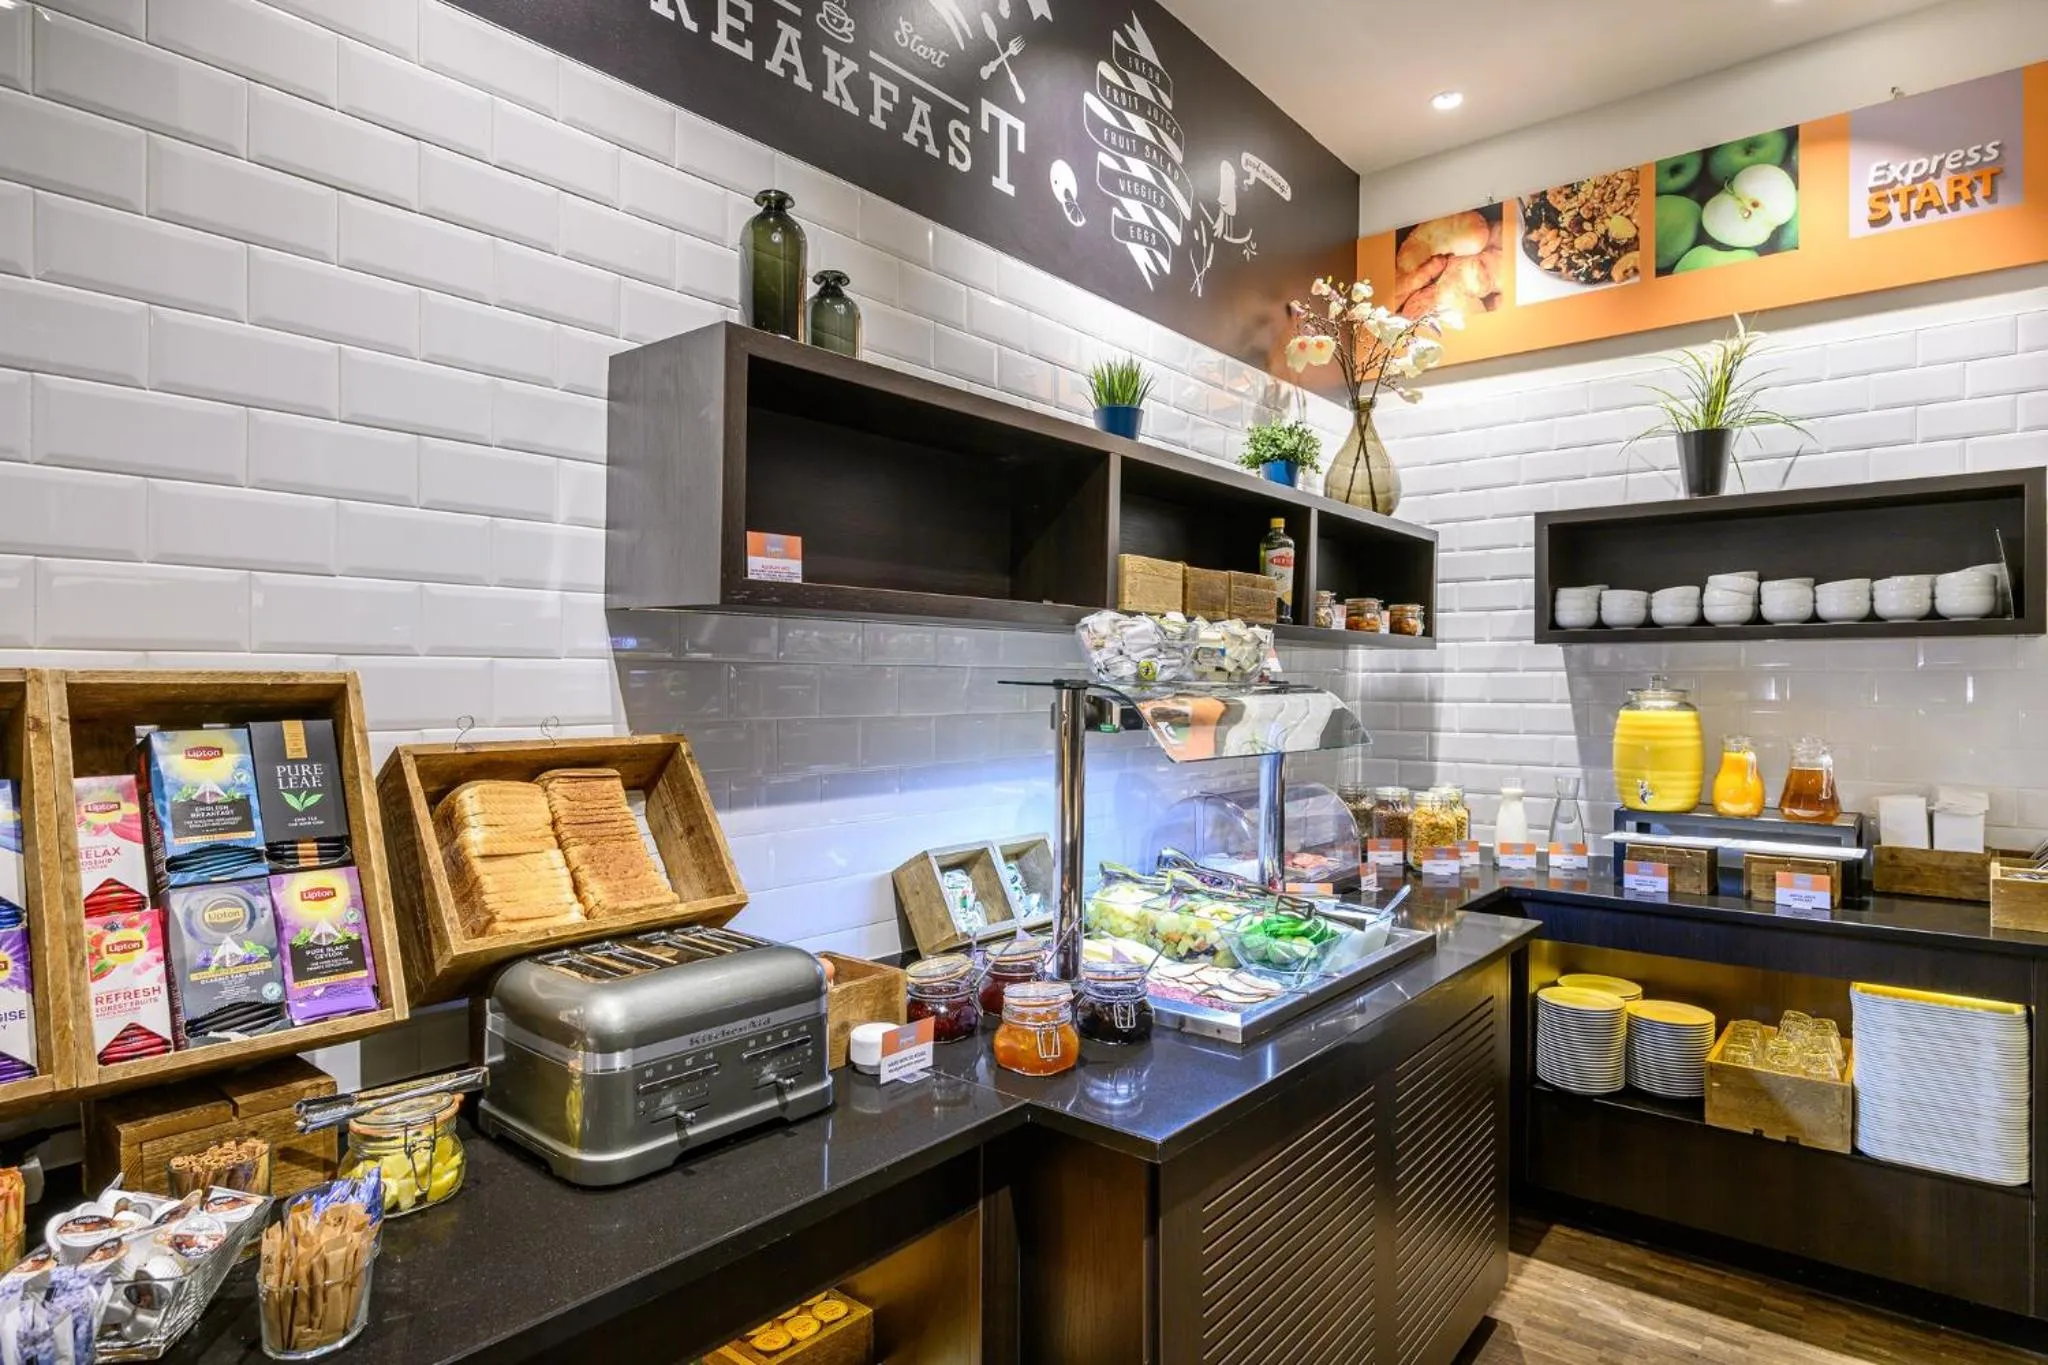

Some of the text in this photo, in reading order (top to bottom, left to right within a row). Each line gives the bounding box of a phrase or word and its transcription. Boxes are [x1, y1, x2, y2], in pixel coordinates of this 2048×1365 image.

[894, 16, 950, 68] Start
[1128, 55, 1161, 85] FRESH
[1105, 84, 1178, 138] FRUIT JUICE
[1103, 127, 1180, 182] FRUIT SALAD
[1868, 140, 2002, 187] Express
[1118, 177, 1166, 209] VEGGIES
[1867, 166, 2003, 226] START
[1129, 225, 1157, 246] EGGS
[187, 748, 220, 758] Lipton
[276, 763, 324, 777] PURE
[88, 802, 118, 812] Lipton
[302, 887, 334, 900] Lipton
[208, 910, 240, 921] Lipton
[109, 941, 141, 953] Lipton
[95, 986, 162, 1006] REFRESH
